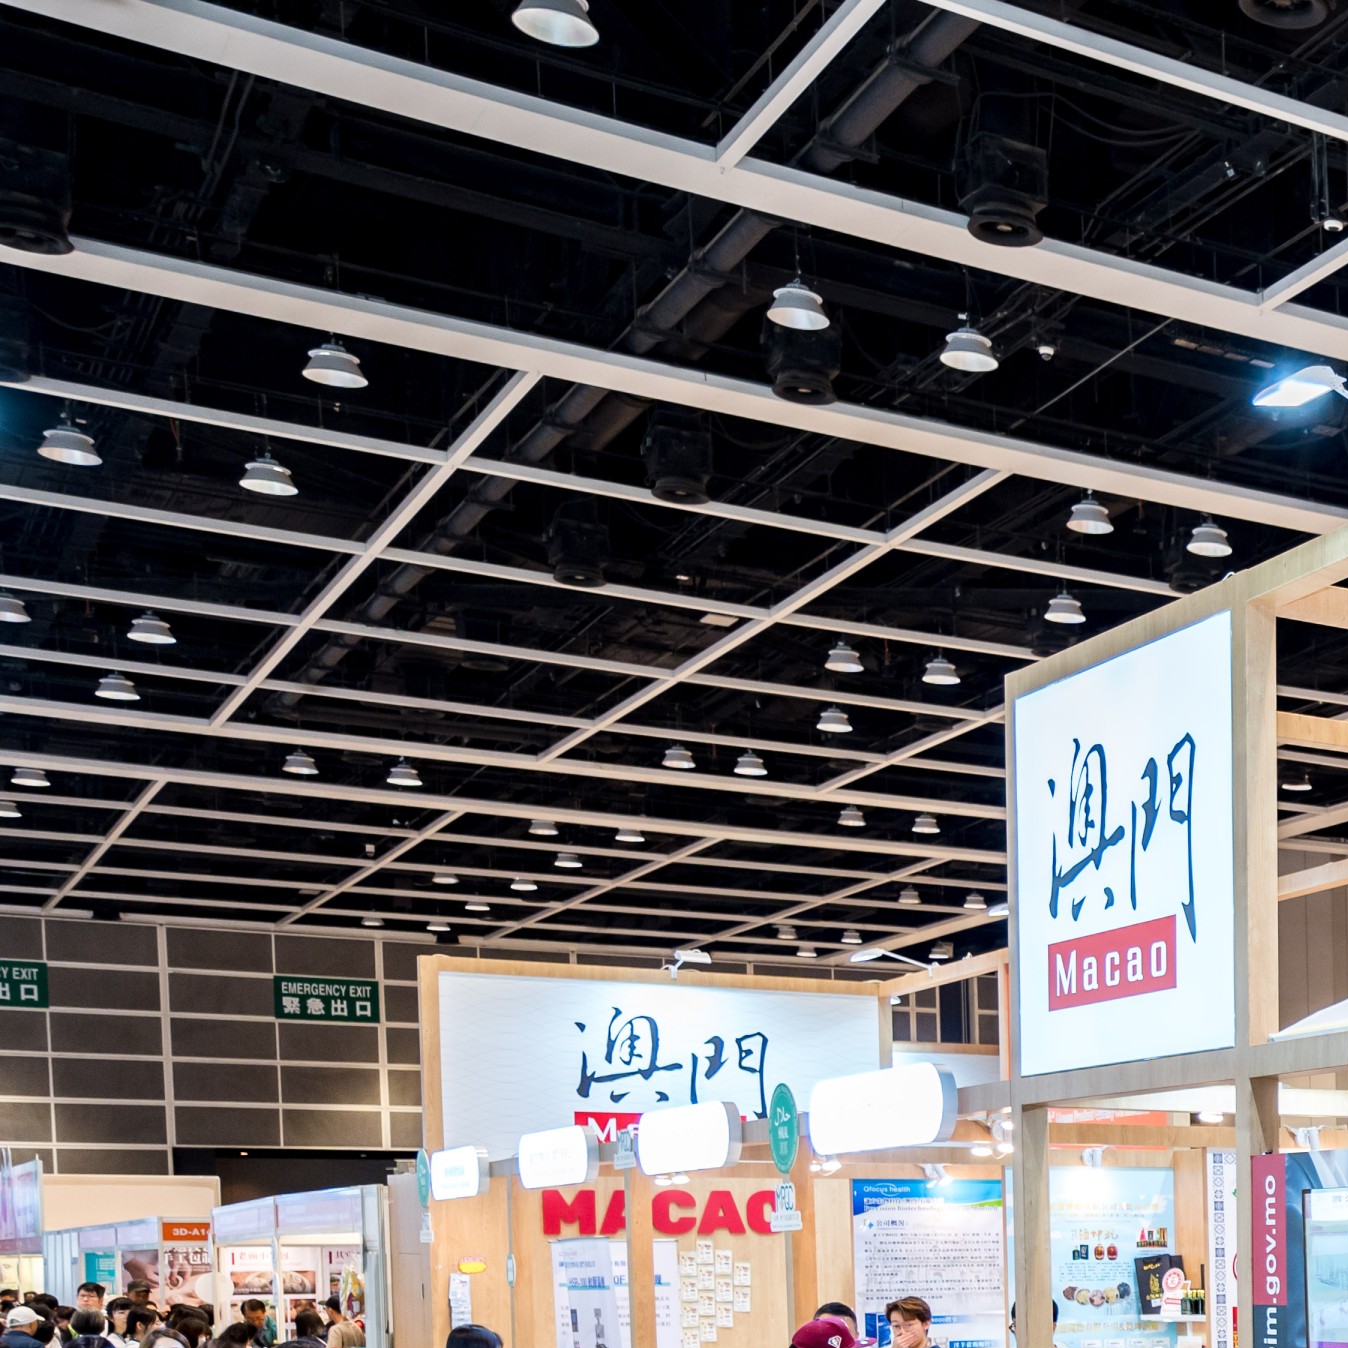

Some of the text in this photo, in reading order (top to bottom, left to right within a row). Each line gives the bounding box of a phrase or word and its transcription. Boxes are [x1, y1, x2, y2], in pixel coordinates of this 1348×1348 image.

[1047, 731, 1199, 945] 澳門
[12, 967, 38, 981] EXIT
[1055, 940, 1169, 997] Macao
[282, 981, 371, 998] EMERGENCY EXIT
[282, 996, 371, 1017] 緊急出口
[890, 1184, 911, 1193] health
[542, 1190, 782, 1236] MACAO
[172, 1228, 211, 1237] 3D-A1
